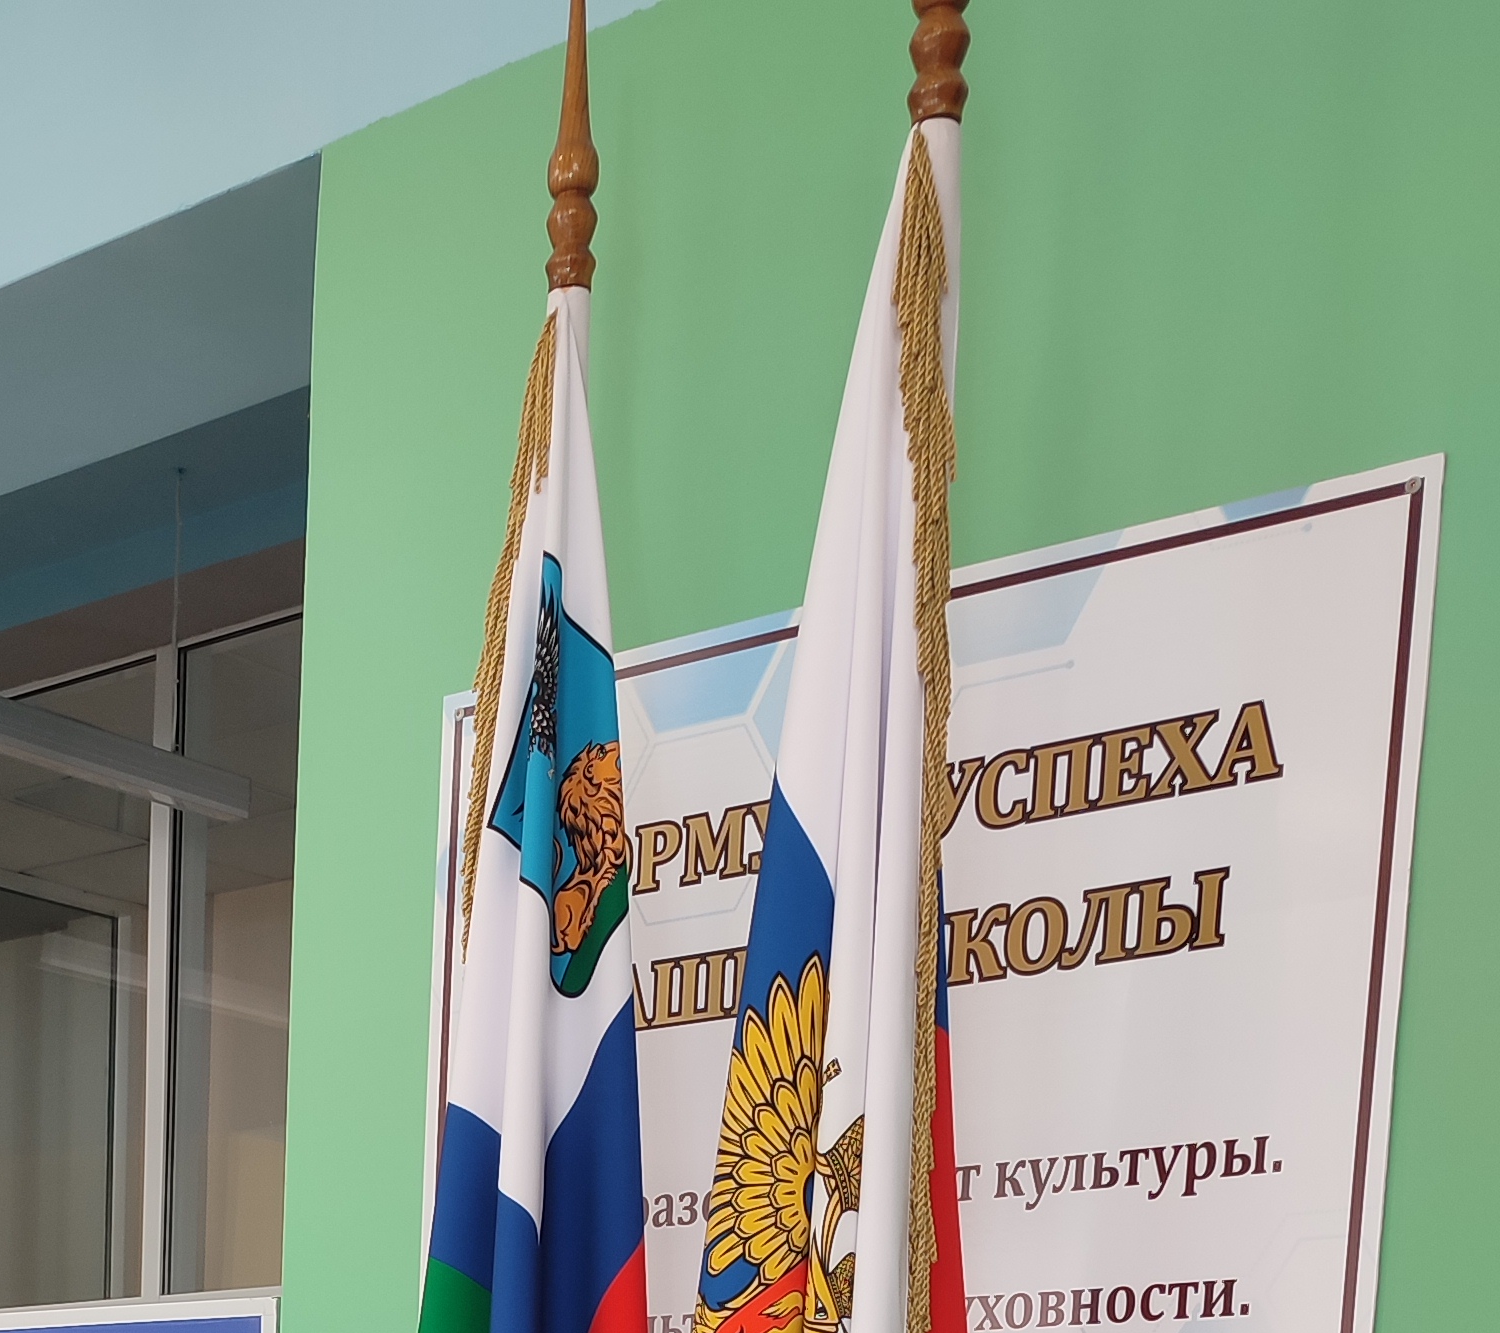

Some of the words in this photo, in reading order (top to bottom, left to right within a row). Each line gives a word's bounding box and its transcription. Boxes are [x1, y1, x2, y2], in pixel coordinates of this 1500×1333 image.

[944, 866, 1232, 987] КОЛЫ
[956, 1164, 982, 1202] т
[993, 1134, 1283, 1210] культуры.
[965, 1277, 1251, 1333] ховности.
